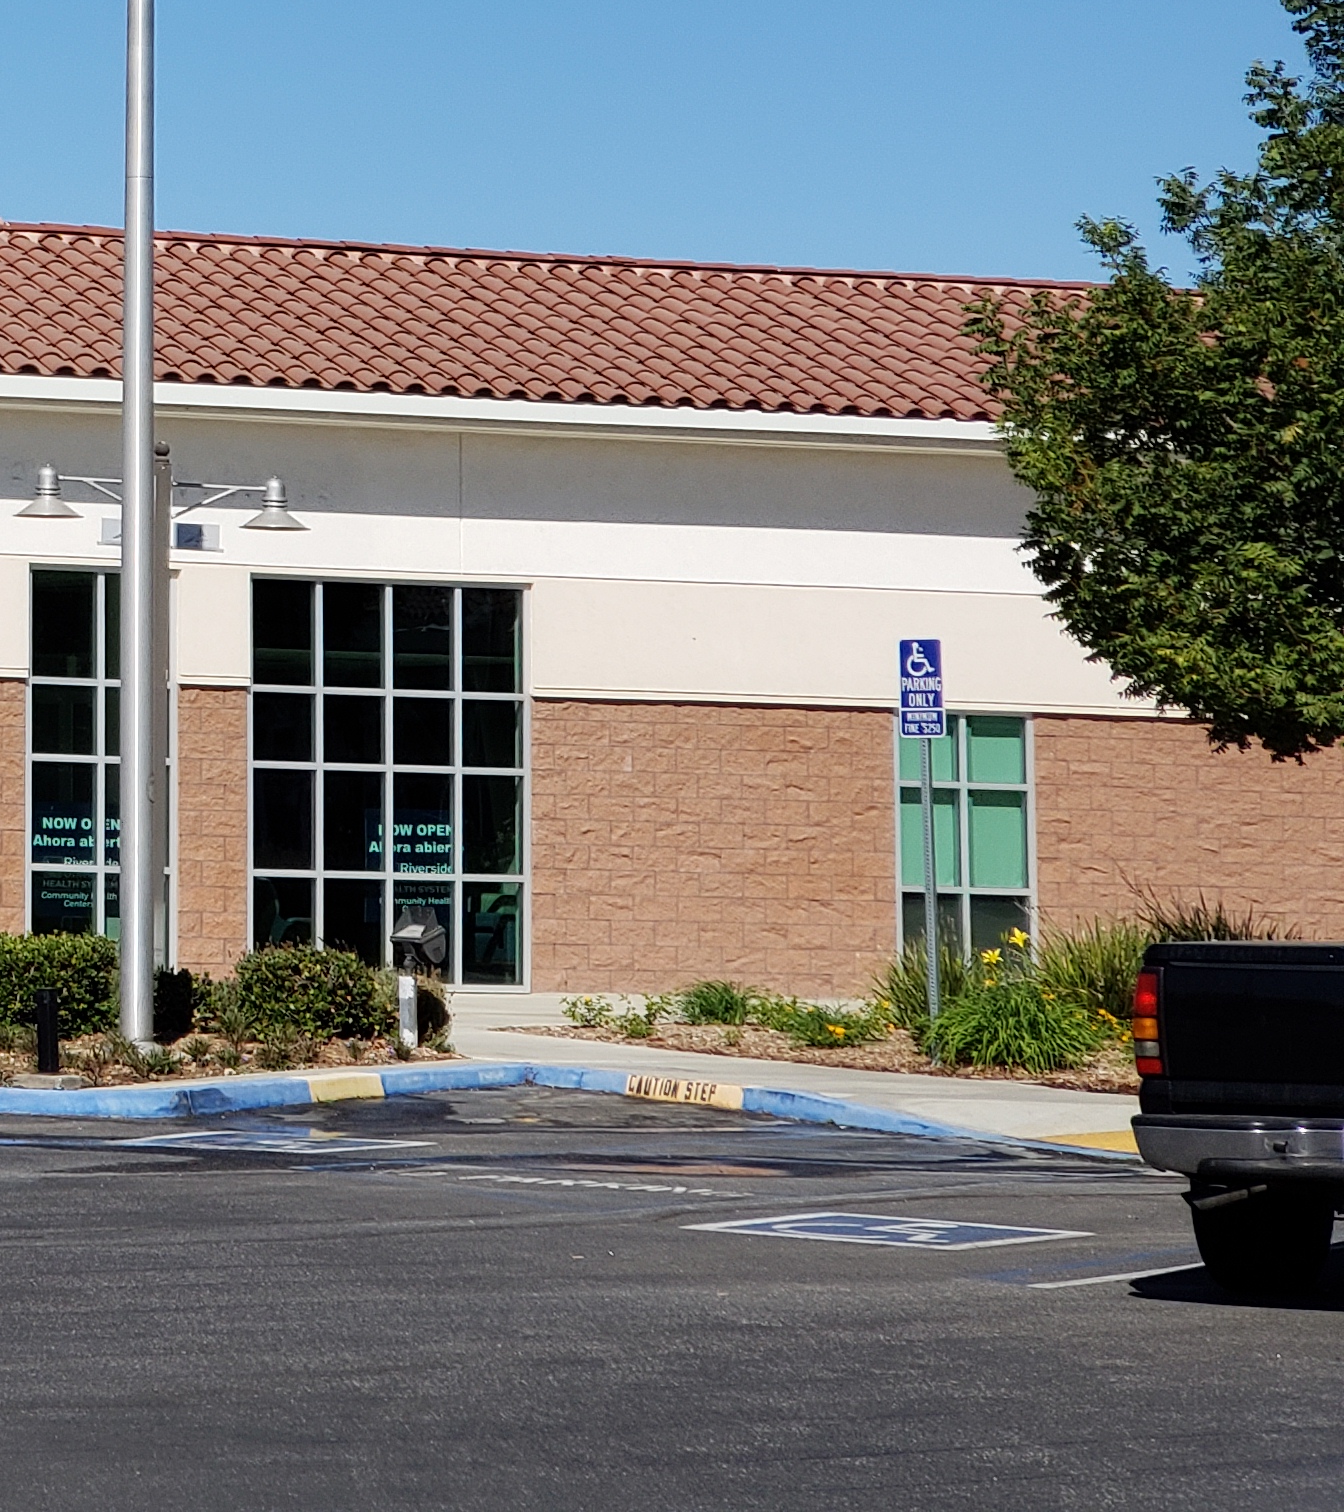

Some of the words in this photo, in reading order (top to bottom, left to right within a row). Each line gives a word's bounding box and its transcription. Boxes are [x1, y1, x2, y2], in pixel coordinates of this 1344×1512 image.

[901, 677, 942, 692] PARKING
[908, 692, 935, 707] ONLY
[904, 723, 920, 734] FINE
[920, 722, 941, 734] $250
[42, 816, 77, 830] NOW
[33, 833, 75, 847] Ahora
[43, 879, 79, 888] HEALTH
[41, 891, 89, 901] Community
[628, 1075, 679, 1099] CAUTION
[684, 1081, 717, 1102] STEP
